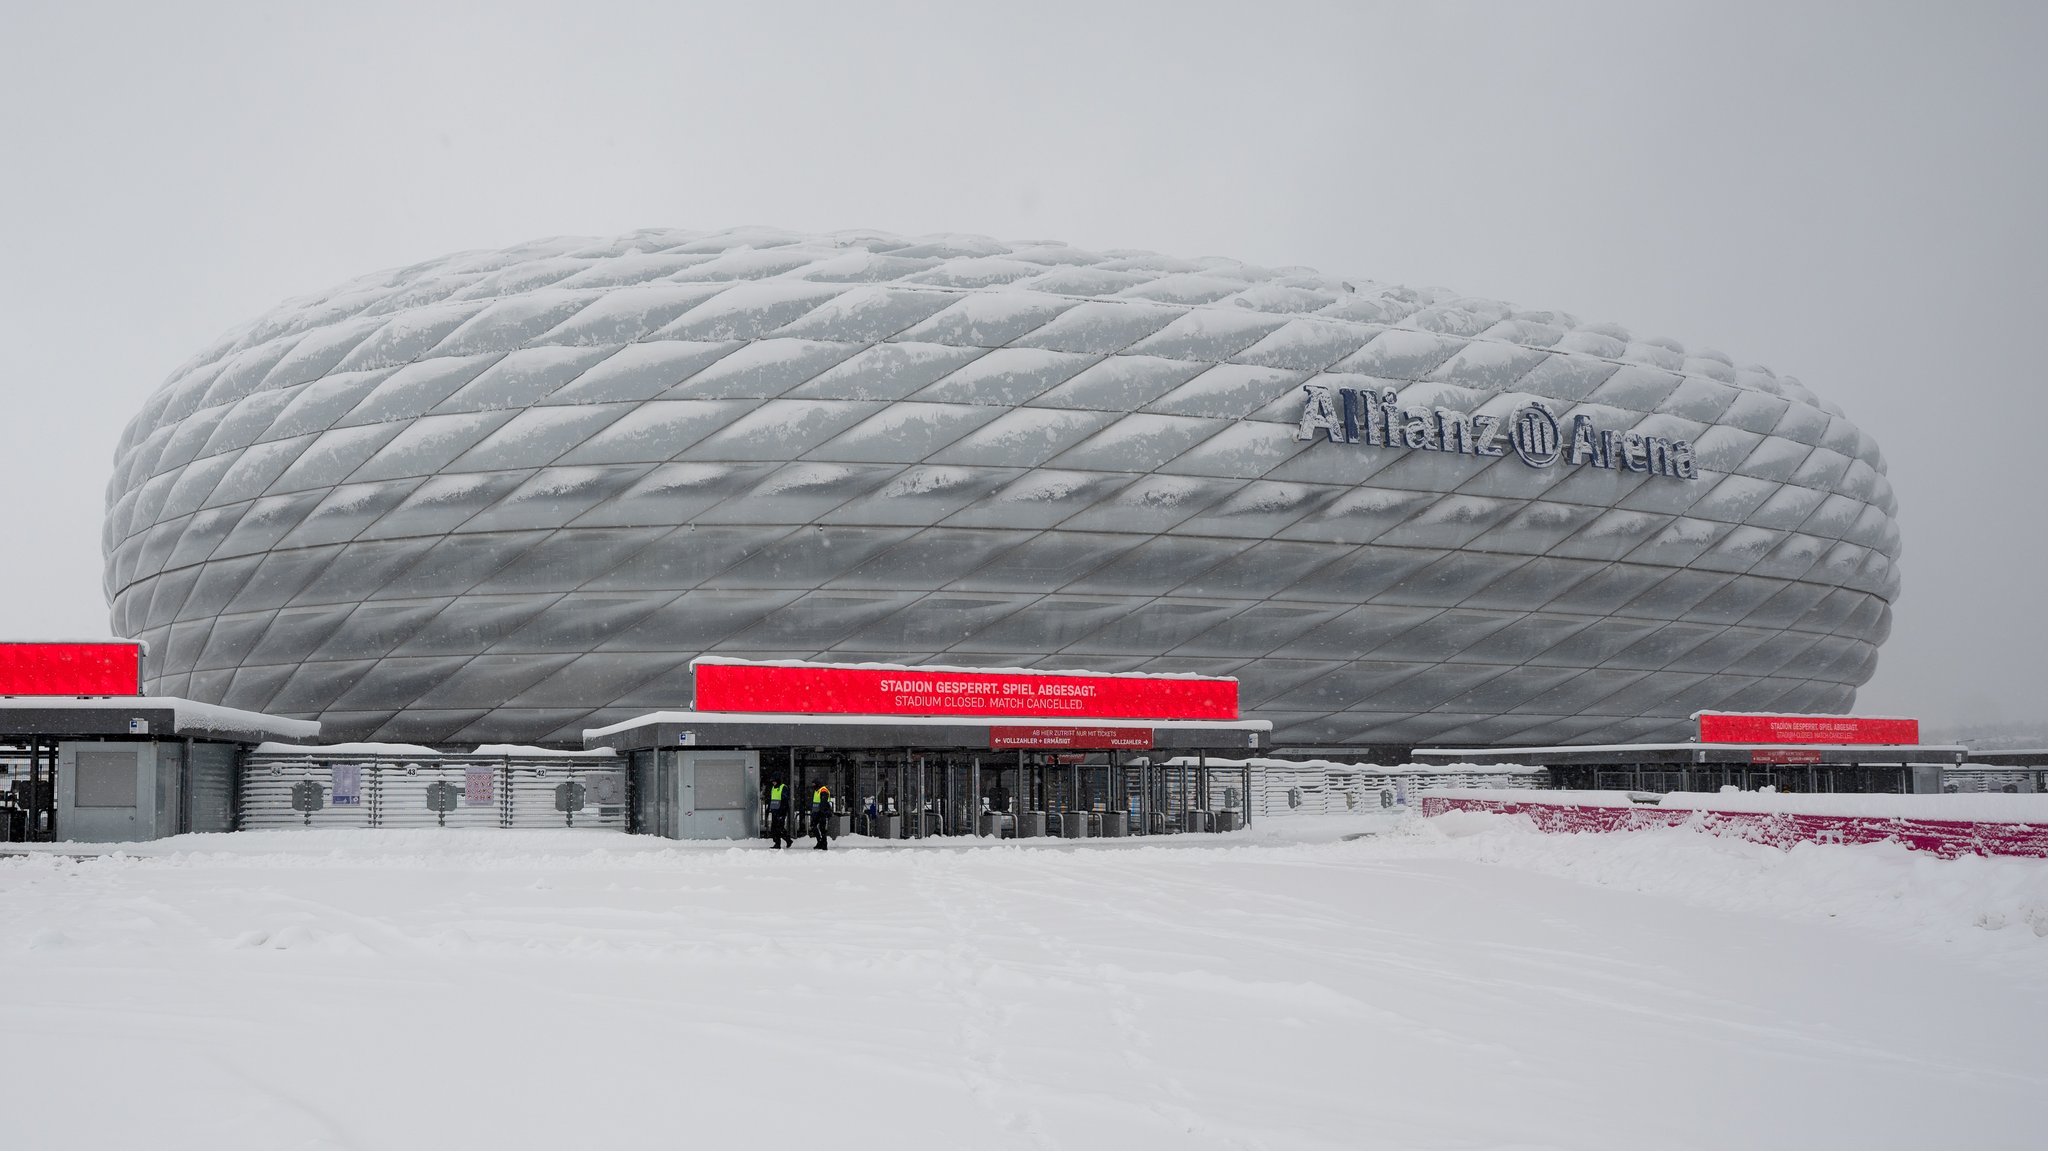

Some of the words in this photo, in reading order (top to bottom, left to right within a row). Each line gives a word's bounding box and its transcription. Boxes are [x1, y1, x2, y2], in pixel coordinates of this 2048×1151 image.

[1297, 384, 1503, 457] Allianz
[1570, 414, 1699, 480] Arena
[880, 679, 933, 693] STADION
[936, 681, 1000, 695] GESPERRT.
[1002, 683, 1035, 695] SPIEL
[1038, 684, 1097, 697] ABGESAGT.
[895, 695, 942, 707] STADIUM
[944, 696, 987, 708] CLOSED.
[990, 697, 1024, 709] MATCH
[1026, 698, 1085, 710] CANCELLED.
[1770, 722, 1792, 730] STADION
[407, 768, 416, 776] 43
[536, 769, 545, 777] 42
